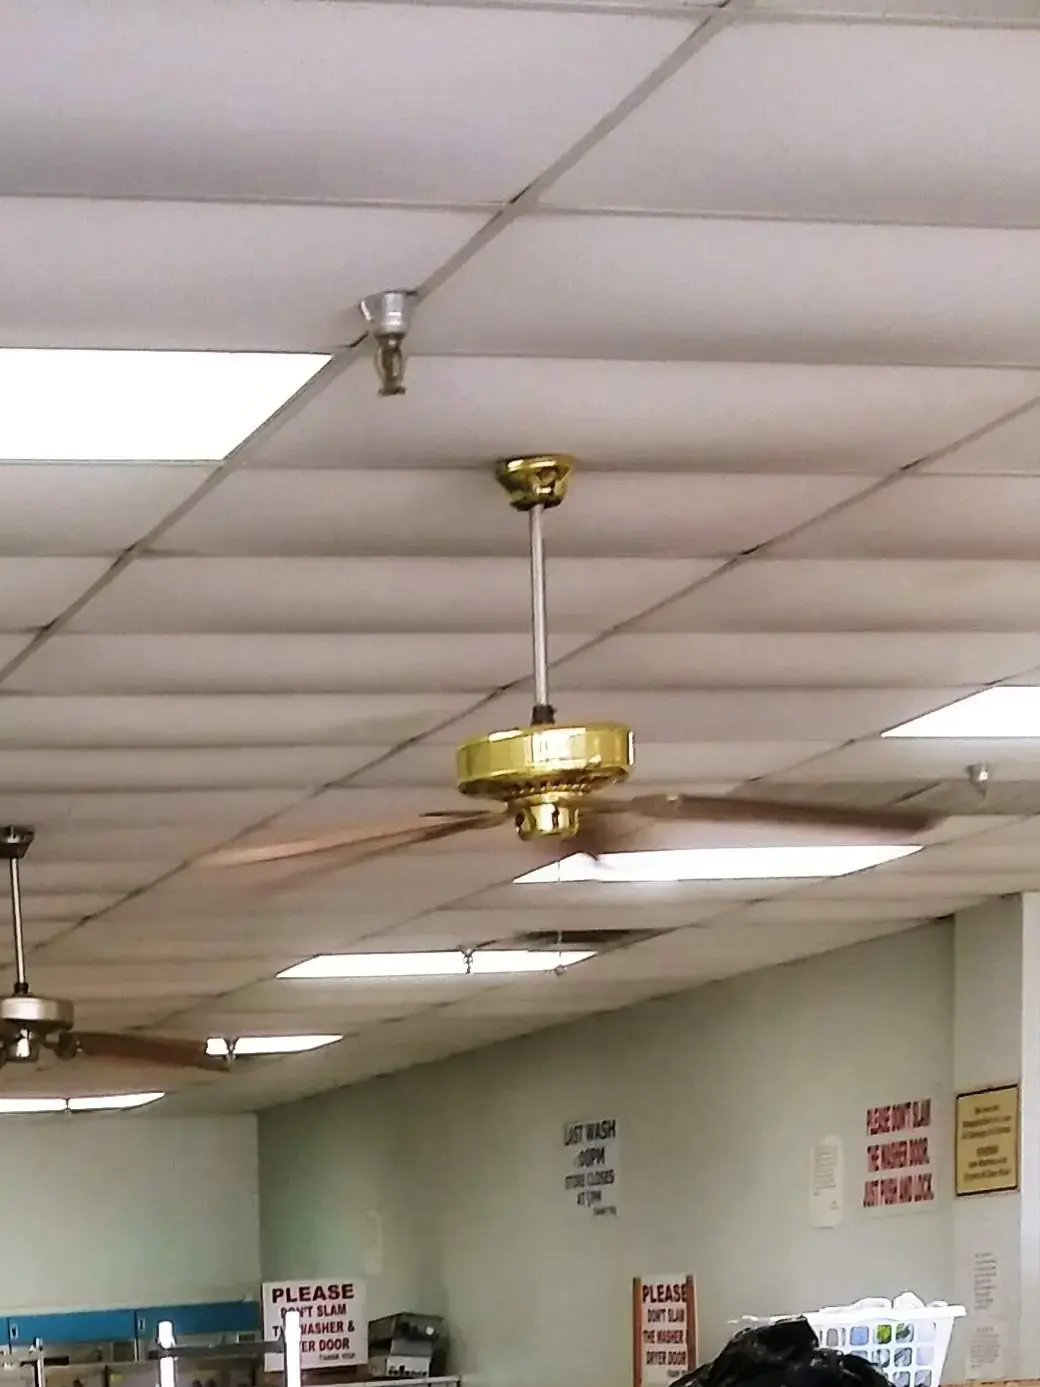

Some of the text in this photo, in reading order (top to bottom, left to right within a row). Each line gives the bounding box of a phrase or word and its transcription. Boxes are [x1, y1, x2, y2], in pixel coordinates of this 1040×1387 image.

[271, 1283, 355, 1304] PLEASE
[642, 1283, 687, 1303] PLEASE
[316, 1303, 347, 1318] SLAM
[347, 1320, 355, 1333] &
[318, 1337, 350, 1352] DOOR
